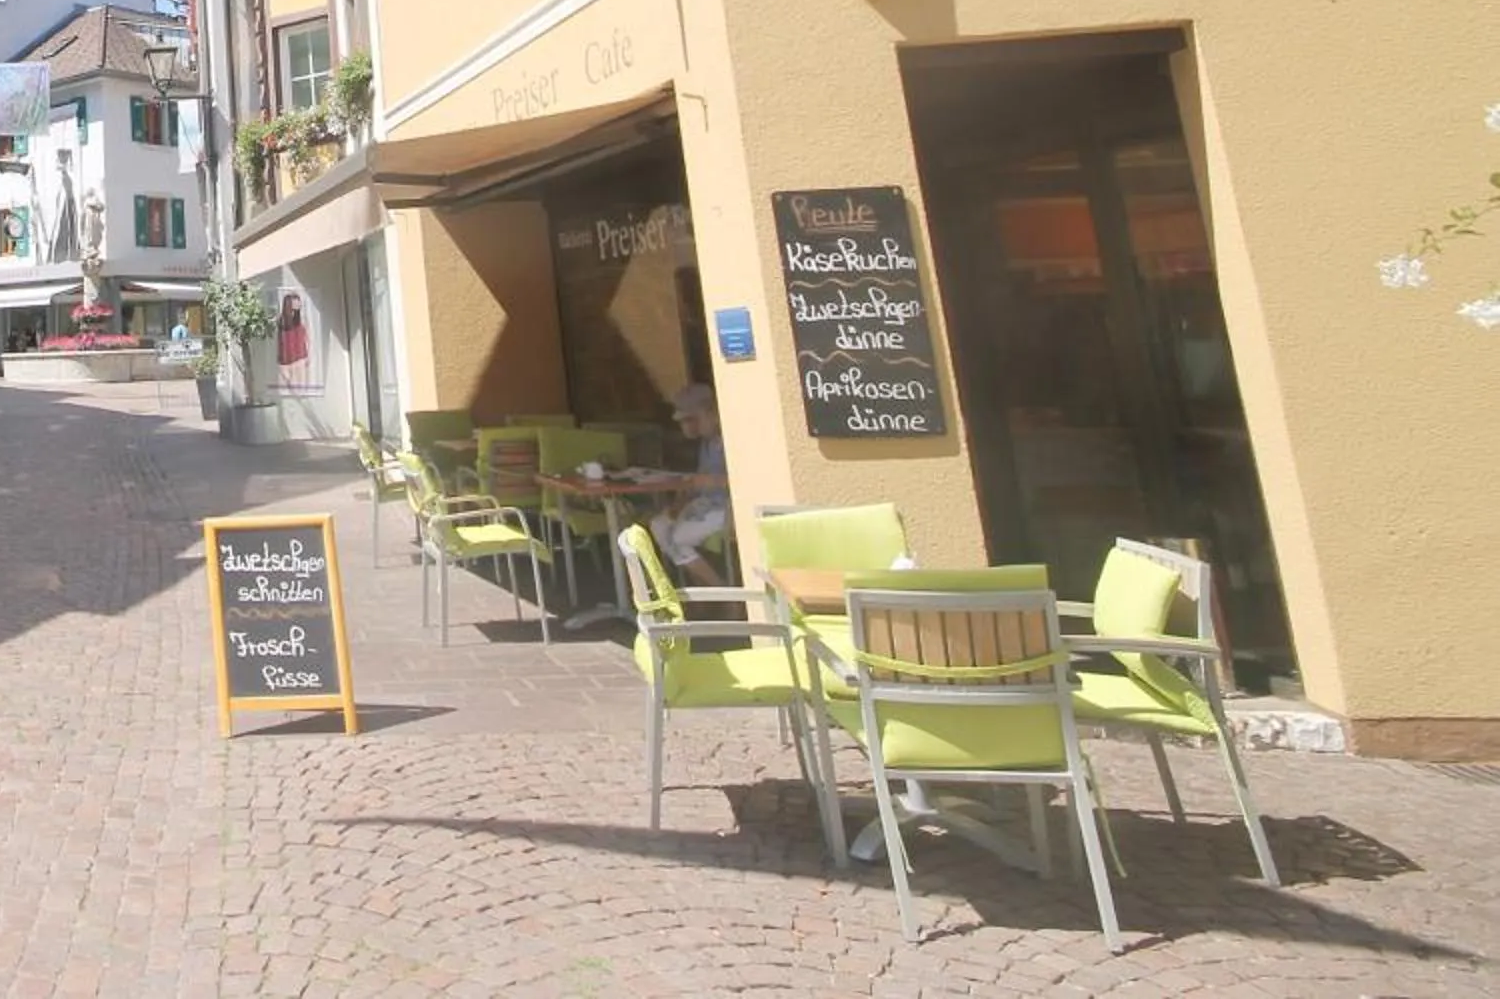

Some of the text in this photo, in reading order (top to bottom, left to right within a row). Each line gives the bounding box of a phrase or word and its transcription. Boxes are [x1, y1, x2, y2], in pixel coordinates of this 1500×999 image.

[492, 68, 560, 122] Preiser
[596, 211, 667, 260] Preiser
[785, 237, 917, 273] Käsekuchen
[835, 323, 906, 350] dünne
[847, 404, 928, 432] dünne
